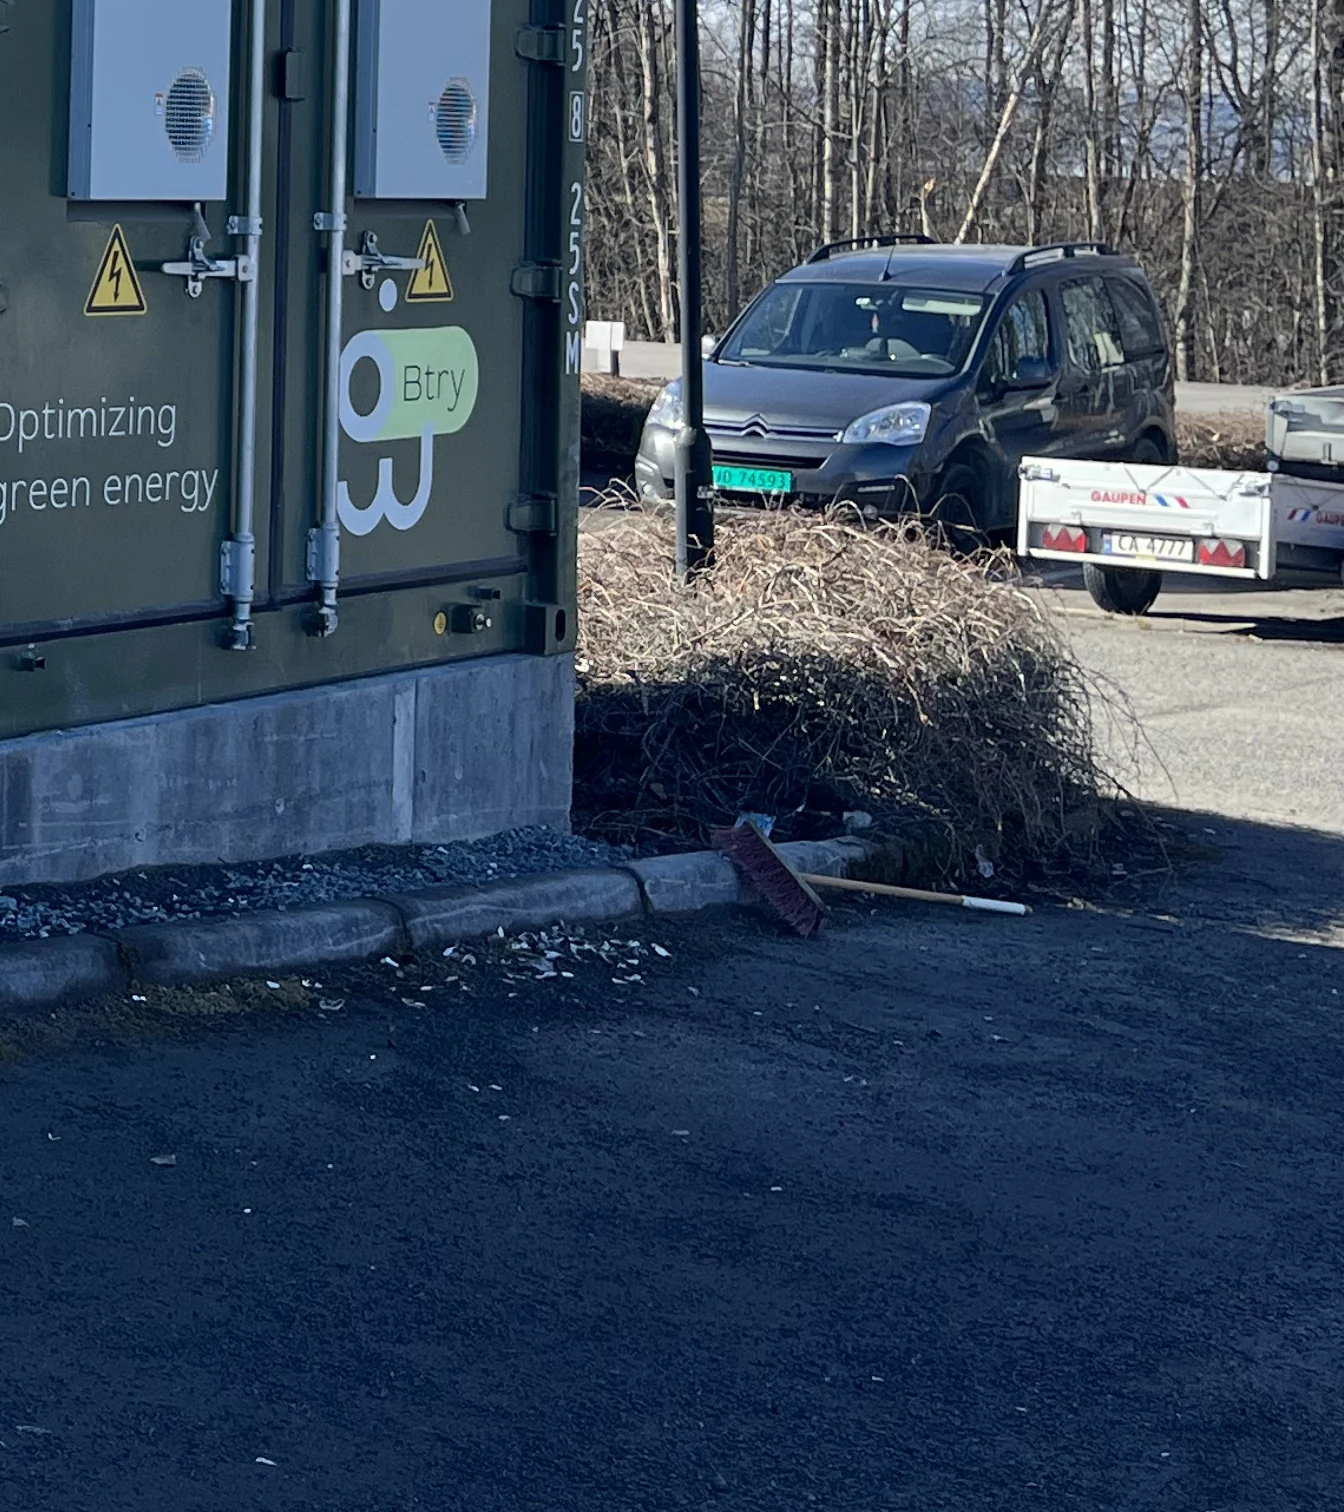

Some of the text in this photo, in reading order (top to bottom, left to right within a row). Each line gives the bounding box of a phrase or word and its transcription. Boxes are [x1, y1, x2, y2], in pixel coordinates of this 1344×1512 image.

[565, 182, 583, 375] 25SM
[403, 364, 465, 412] Btry
[103, 468, 219, 513] energy
[739, 471, 787, 489] 74593
[1091, 490, 1147, 505] GAUPEN
[1118, 534, 1187, 556] CA 4777
